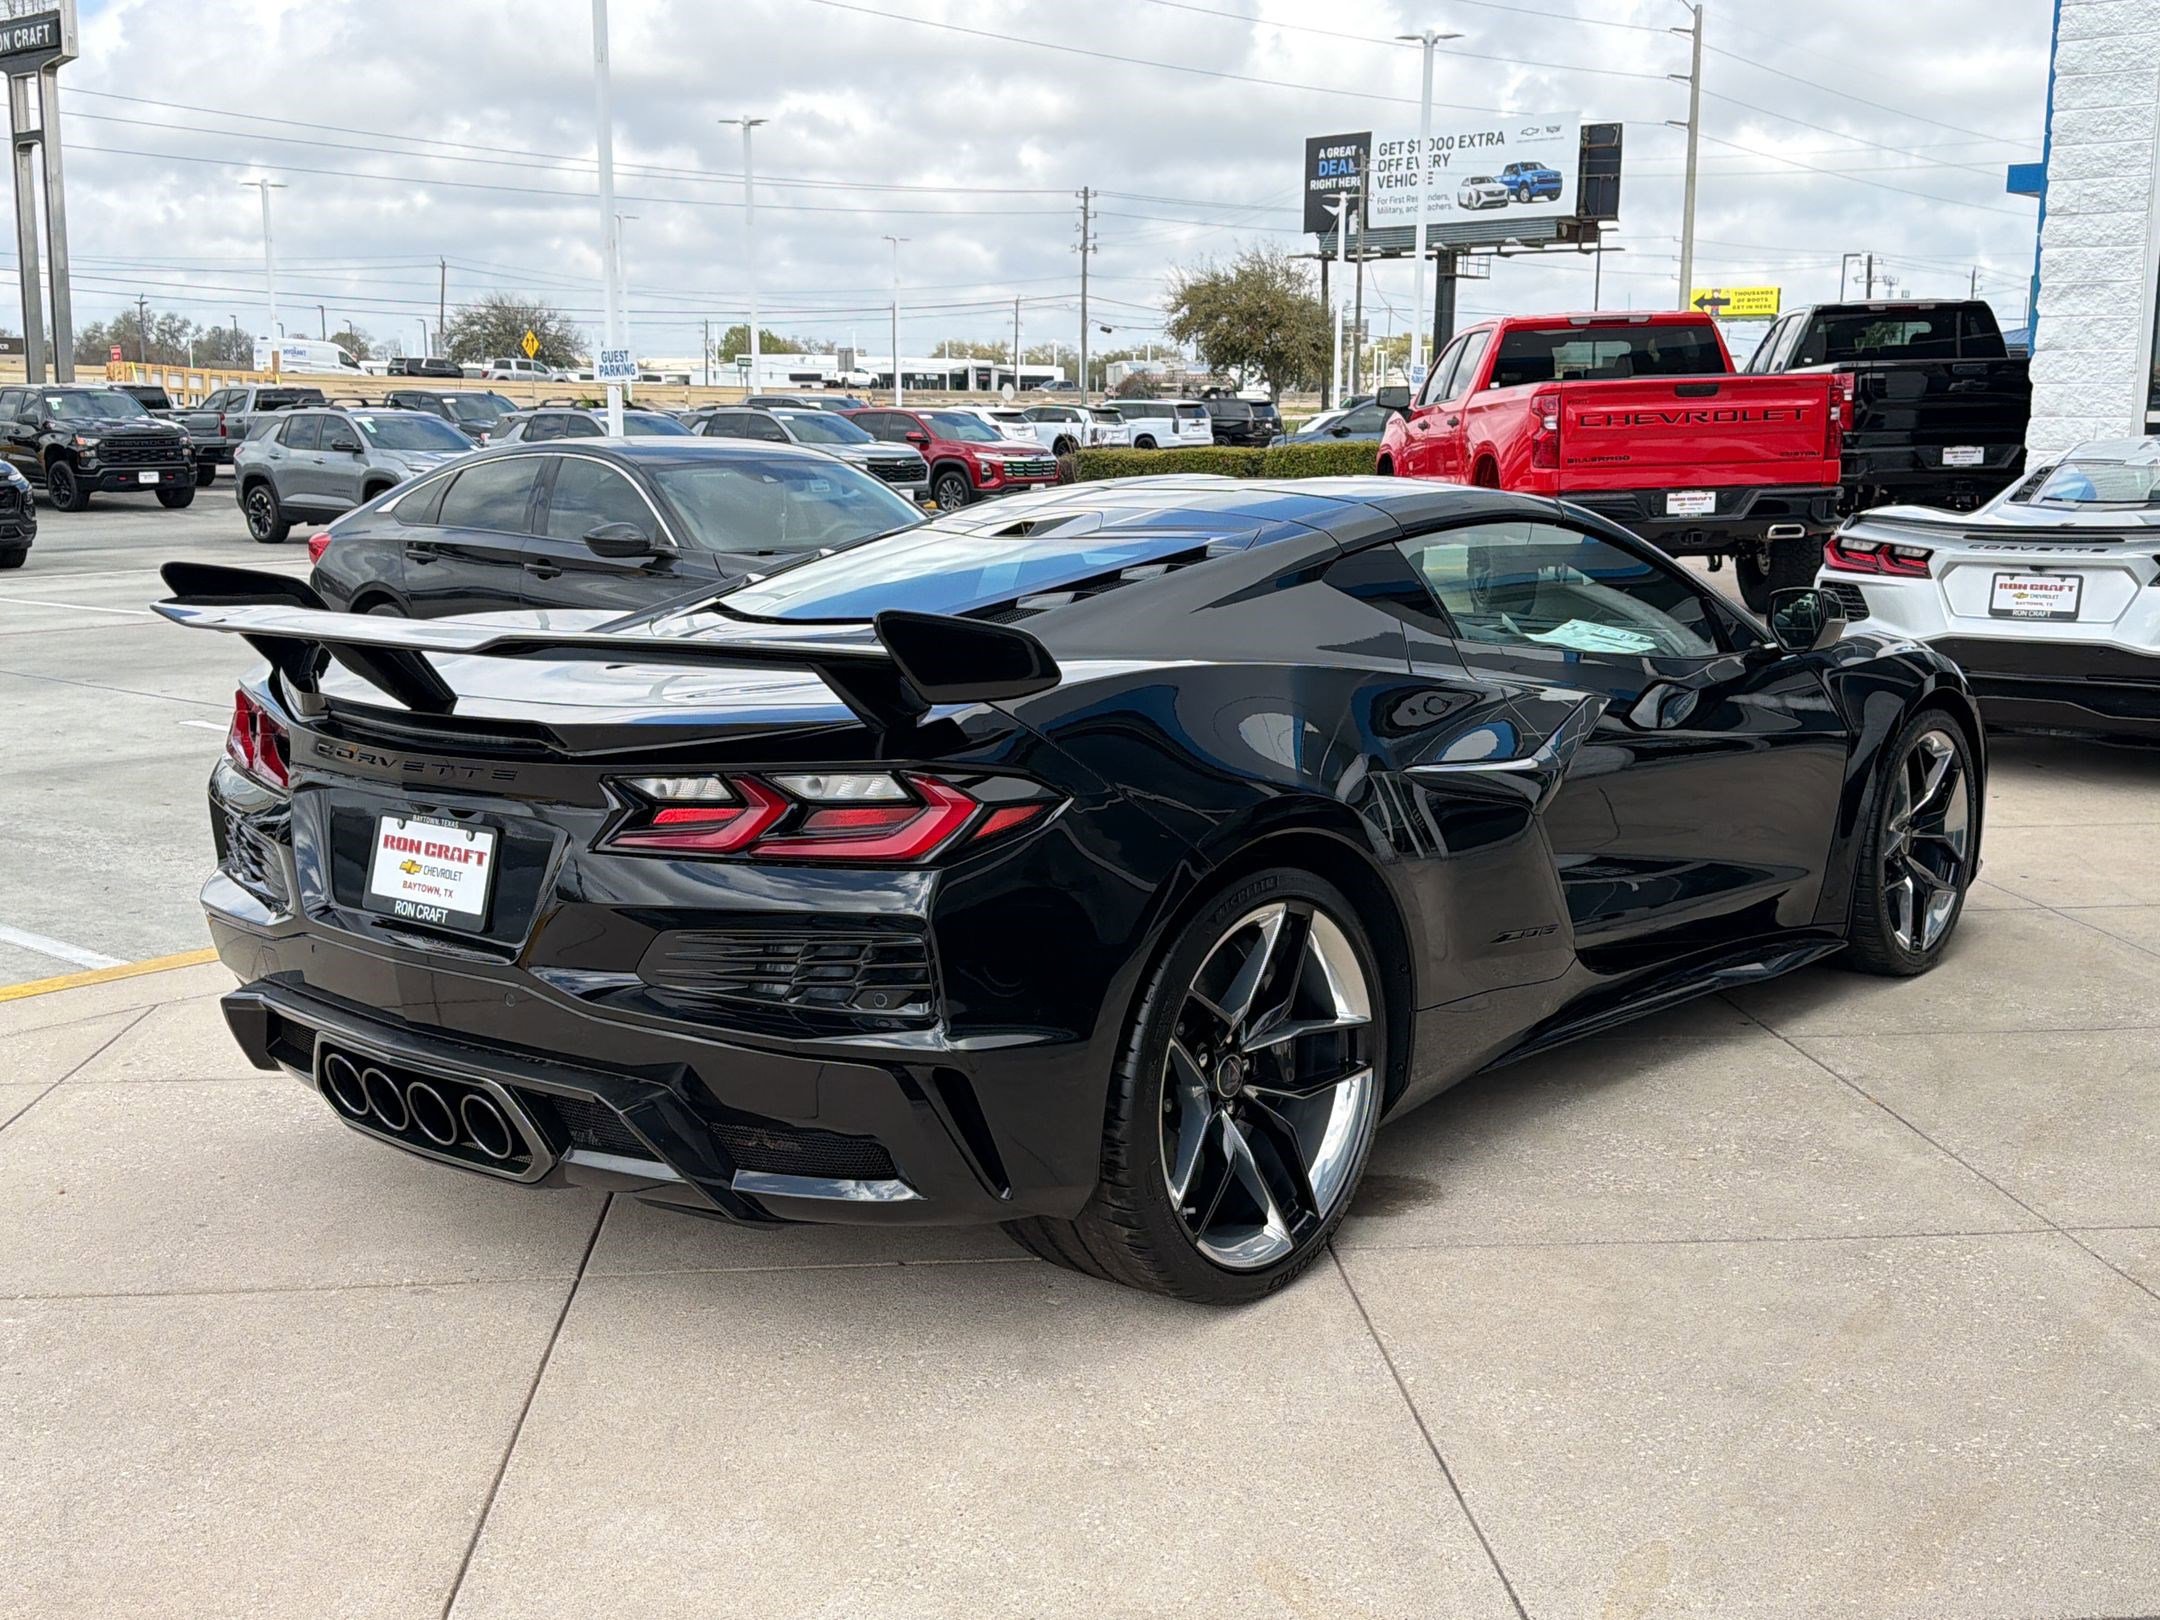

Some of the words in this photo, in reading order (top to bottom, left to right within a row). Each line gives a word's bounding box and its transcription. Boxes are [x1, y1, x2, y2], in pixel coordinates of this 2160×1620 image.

[14, 24, 50, 49] CRAFT
[1379, 141, 1405, 156] GET
[1407, 136, 1455, 154] $1000
[1458, 131, 1505, 149] EXTRA
[1318, 148, 1326, 159] A
[1326, 145, 1357, 158] GREAT
[1318, 158, 1356, 177] DEAL
[1378, 158, 1403, 173] OFF
[1310, 178, 1337, 190] RIGHT
[1338, 176, 1361, 188] HERE
[1377, 171, 1434, 189] VEHICE
[600, 350, 628, 363] GUEST
[599, 363, 636, 377] PARKING
[1579, 408, 1810, 427] CHEVROLET
[1567, 454, 1631, 464] SILVERADO
[1968, 544, 2109, 553] CORVETTE
[1999, 582, 2028, 591] RON
[2029, 583, 2076, 592] CRAFT
[2012, 609, 2028, 617] RON
[2028, 610, 2052, 618] CRAFT
[316, 742, 519, 782] CORVETTE
[412, 814, 440, 826] BAYTOWN,
[441, 819, 459, 829] TEXAS
[383, 834, 422, 856] RON
[424, 842, 487, 867] CRAFT
[423, 865, 463, 882] CHEVROLET
[402, 880, 442, 898] BAYTOWN,
[444, 888, 454, 898] TX
[394, 900, 416, 919] RON
[415, 904, 449, 924] CRAFT
